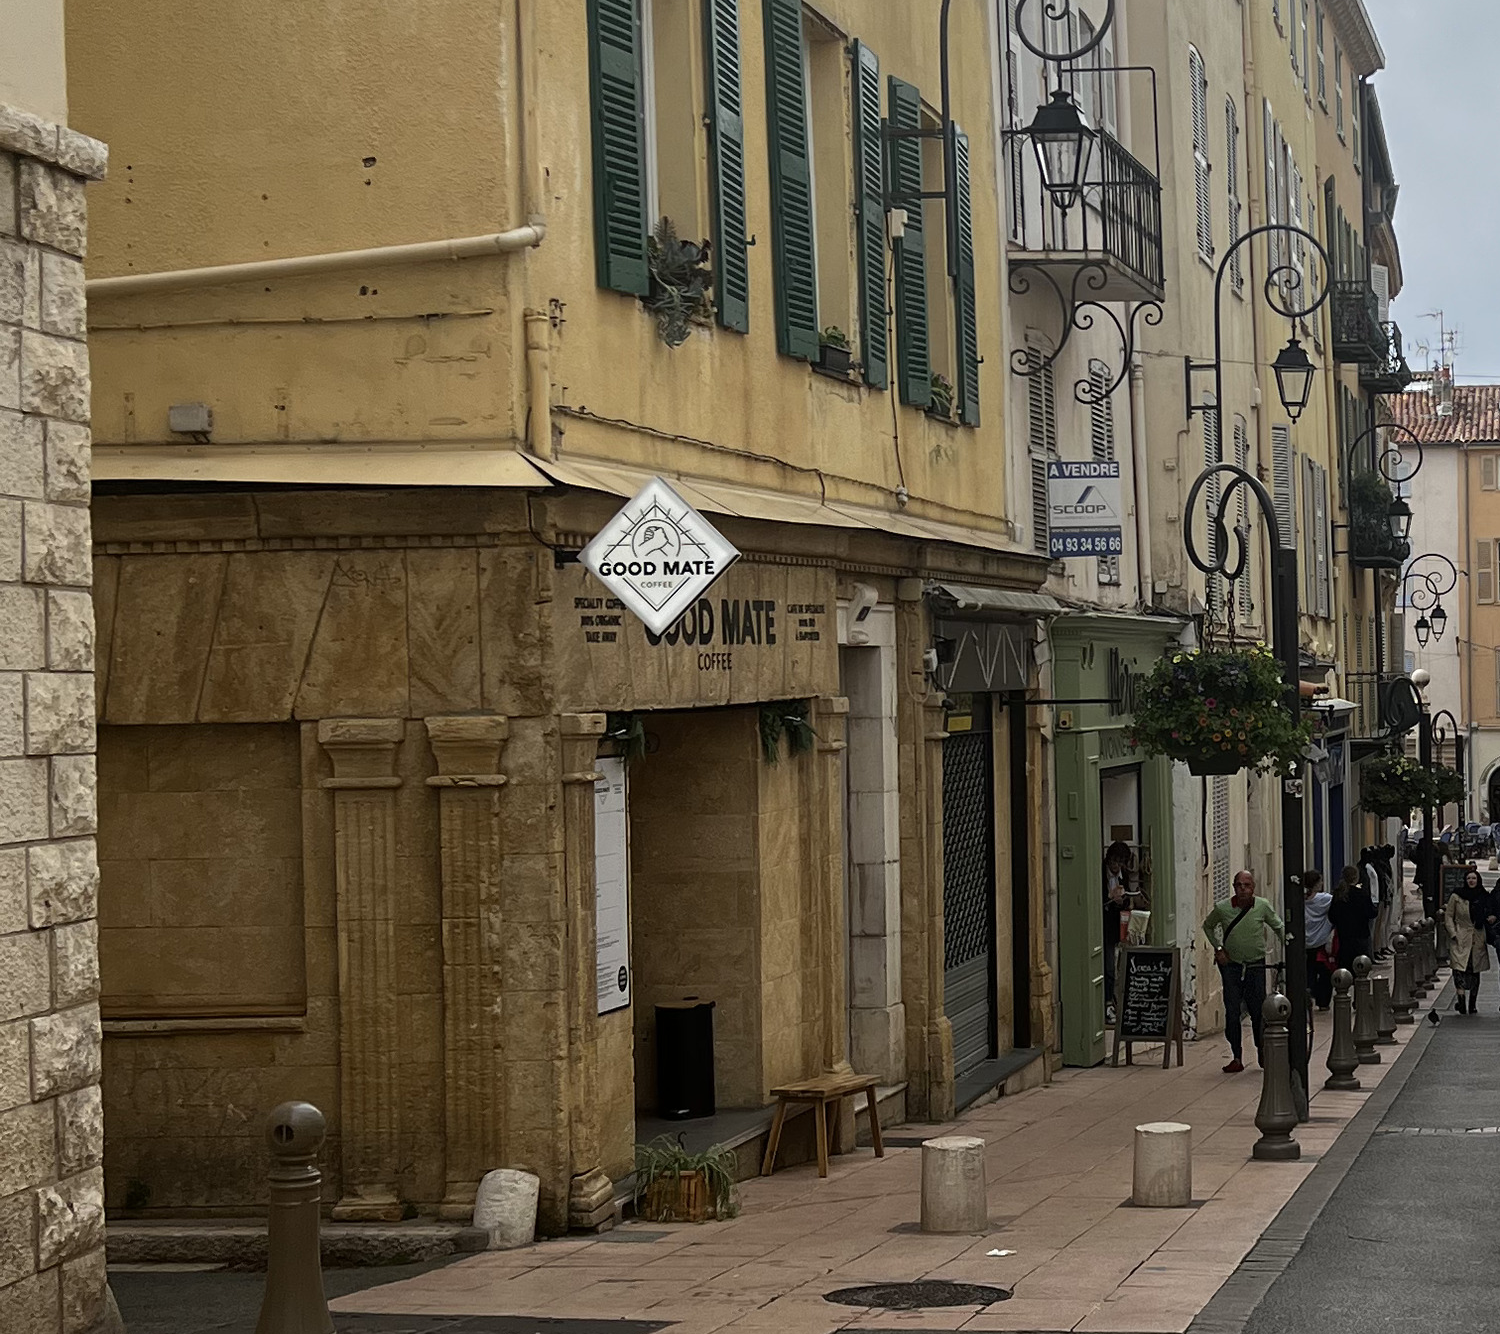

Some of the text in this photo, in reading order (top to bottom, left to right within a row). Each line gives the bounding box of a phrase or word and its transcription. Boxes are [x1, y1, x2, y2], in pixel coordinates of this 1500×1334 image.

[1049, 463, 1118, 477] A VENDRE
[1053, 505, 1106, 515] SCOOP
[1051, 536, 1120, 552] 04 93 34 56 66
[599, 560, 715, 577] GOOD MATE
[640, 581, 673, 589] COFFEE
[721, 599, 776, 646] MATE
[698, 653, 732, 671] COFFEE
